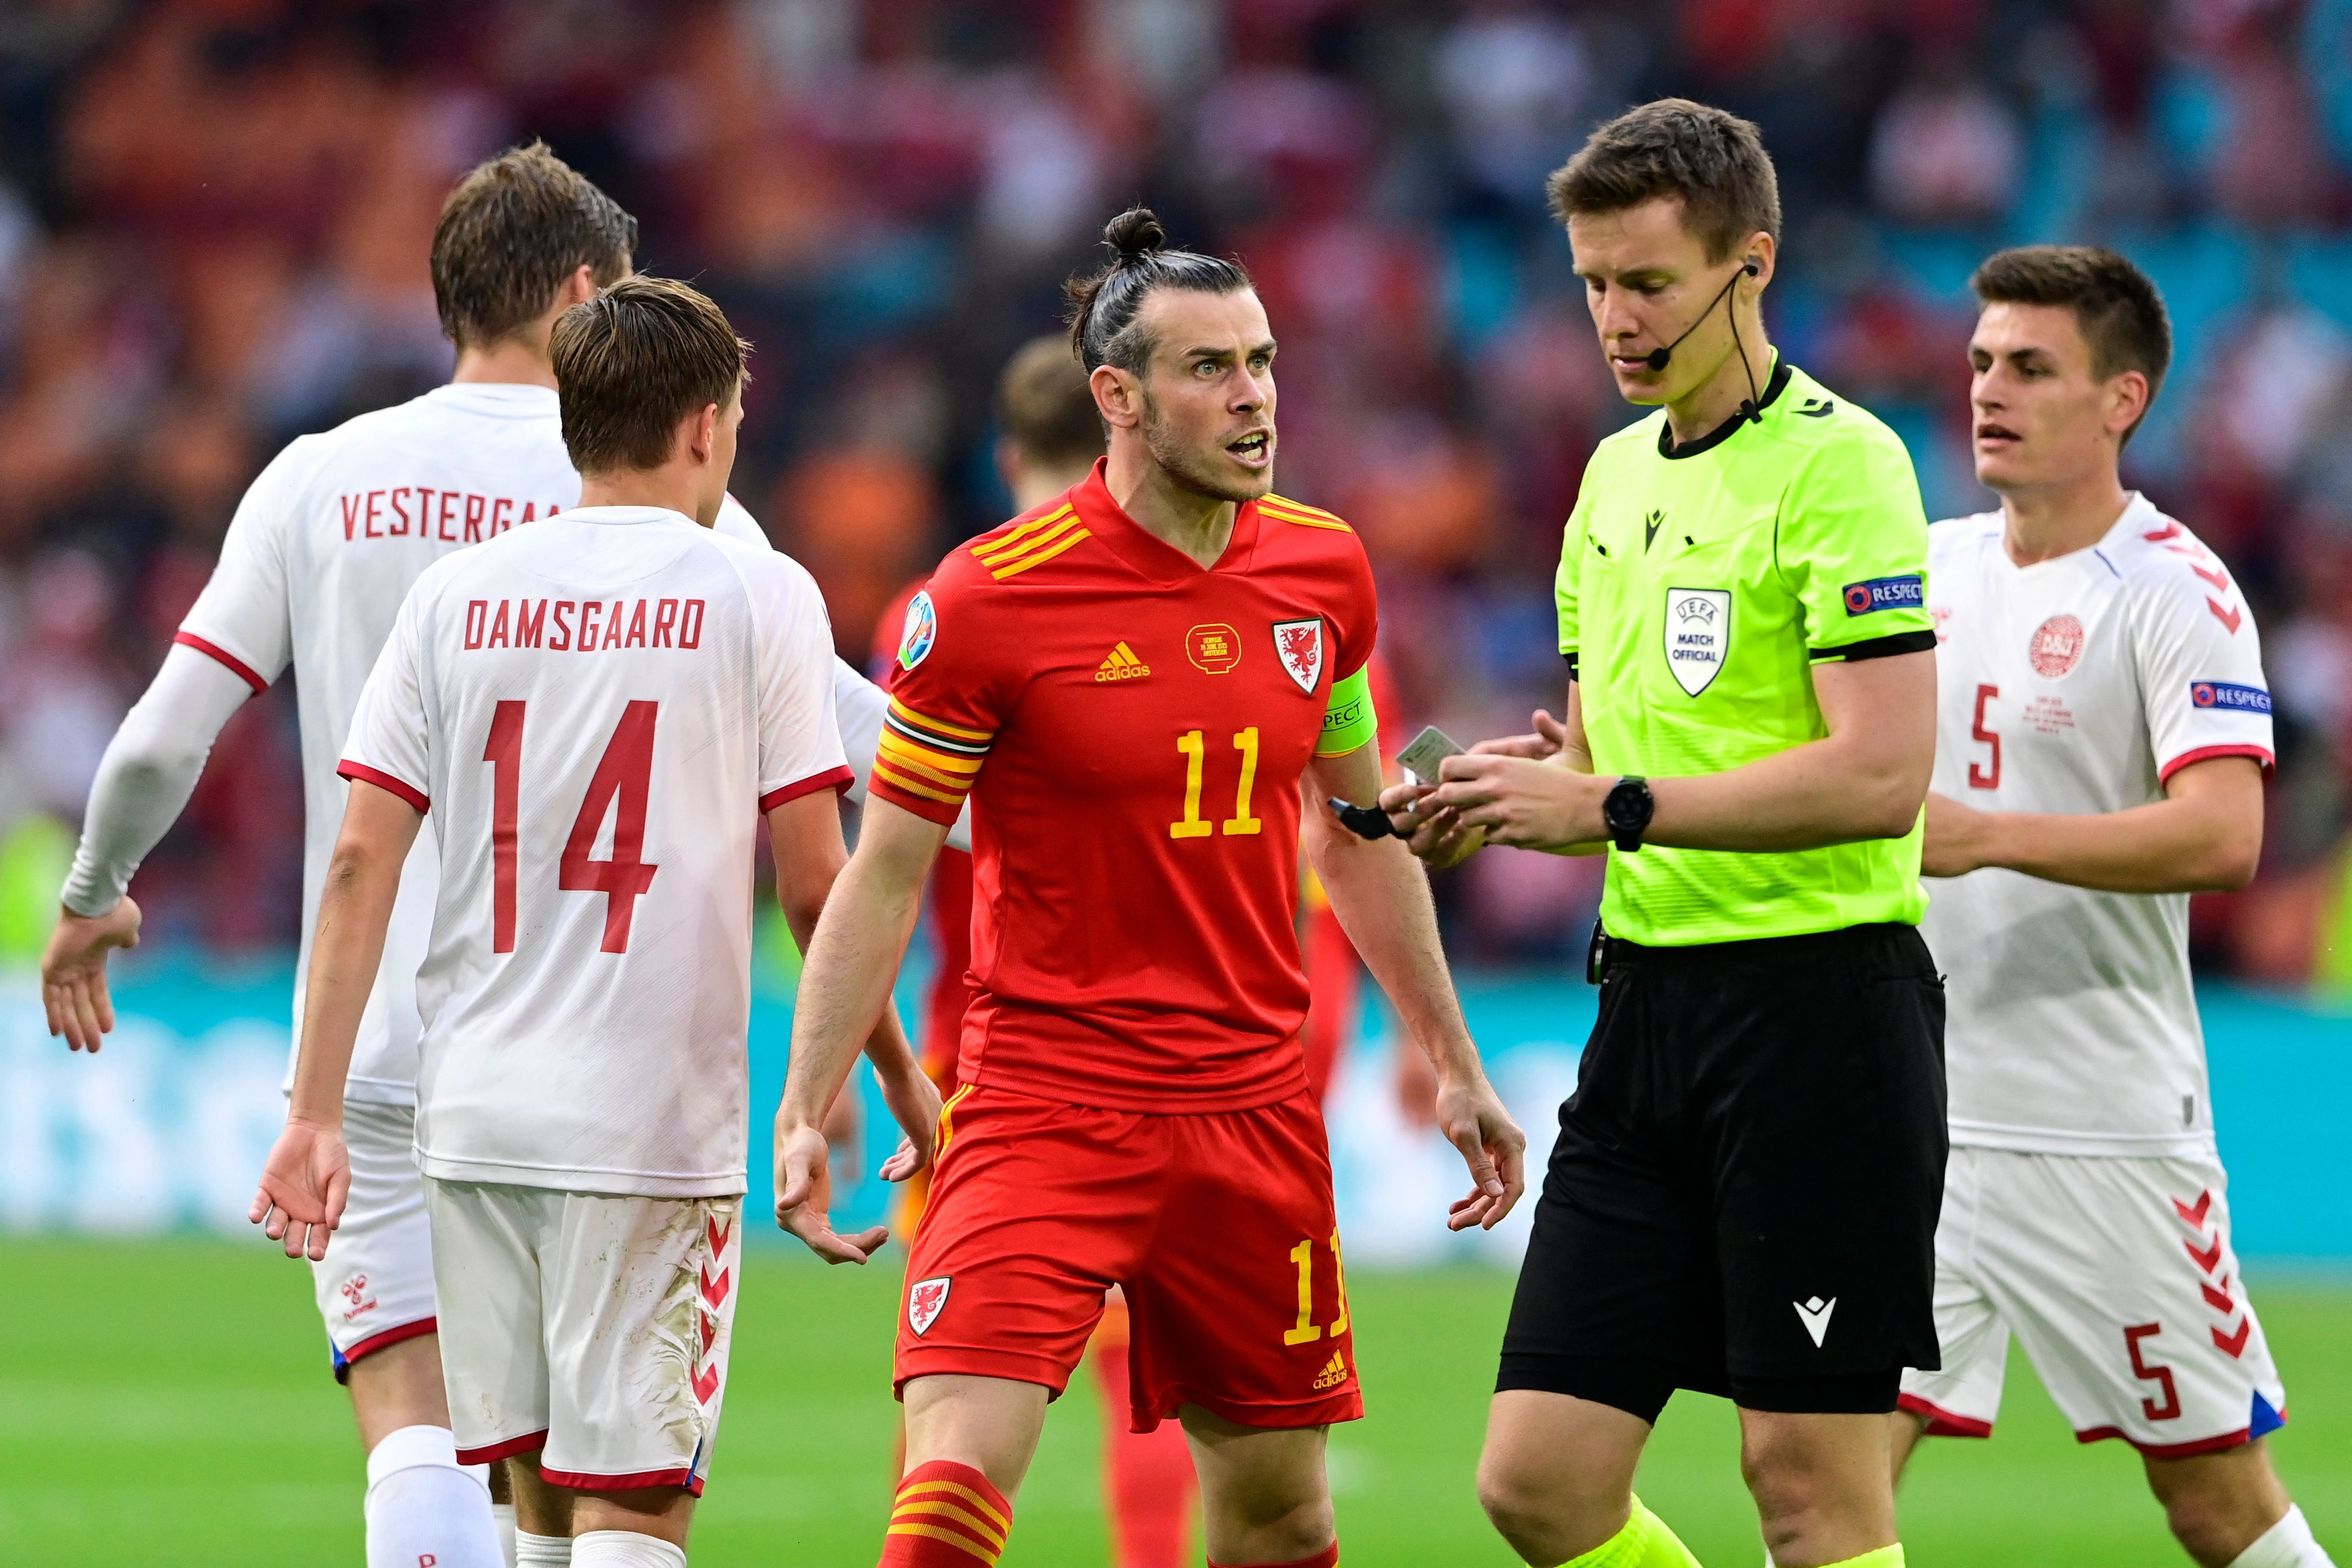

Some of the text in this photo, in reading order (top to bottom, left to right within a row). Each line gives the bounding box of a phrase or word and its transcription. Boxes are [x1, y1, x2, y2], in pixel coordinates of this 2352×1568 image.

[464, 598, 706, 652] DAMSGAARD
[1676, 601, 1714, 622] UEFA
[1673, 649, 1717, 662] OFFICIAL
[1677, 634, 1714, 646] MATCH
[1094, 665, 1151, 682] adidas
[1968, 683, 2001, 791] 5
[1170, 726, 1261, 839] 11
[483, 699, 660, 954] 14
[1283, 1226, 1348, 1346] 11
[1313, 1369, 1347, 1390] adidas
[2124, 1323, 2181, 1421] 5
